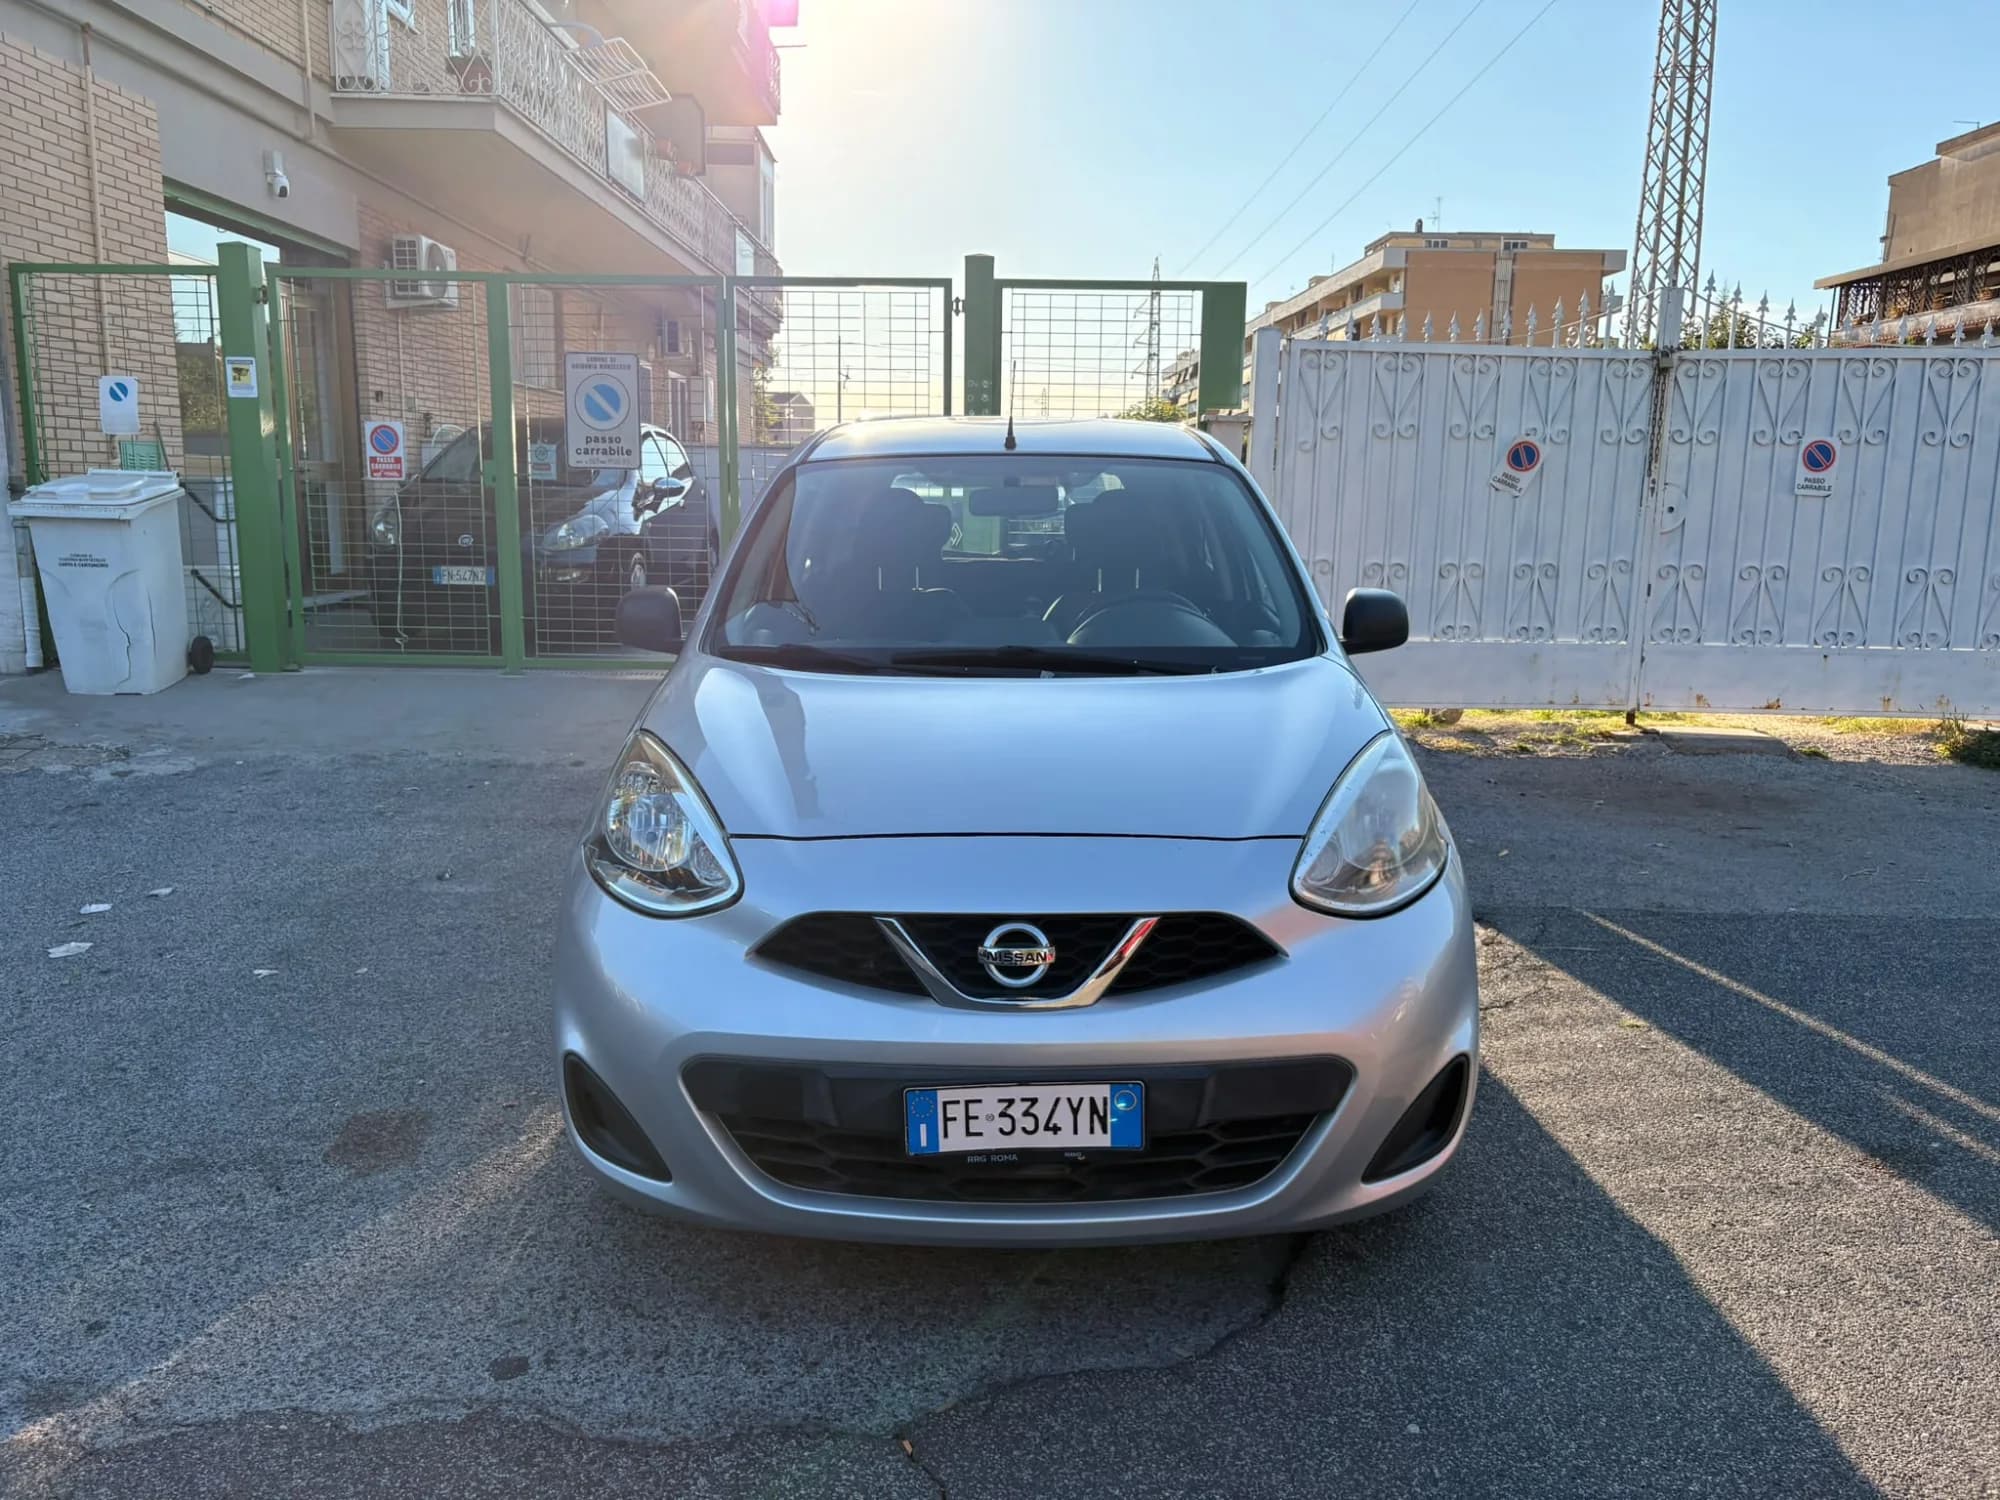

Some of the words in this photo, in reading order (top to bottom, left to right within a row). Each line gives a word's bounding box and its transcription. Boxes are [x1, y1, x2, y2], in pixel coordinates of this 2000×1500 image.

[585, 435, 622, 446] passo
[575, 445, 633, 457] carrabile
[1502, 471, 1521, 484] PASSO
[1803, 476, 1826, 485] PASSO
[1492, 475, 1522, 493] CARRABILE
[1796, 483, 1833, 492] CARRABILE
[985, 951, 1047, 962] NISSAN
[967, 1154, 987, 1164] RRG
[990, 1153, 1019, 1163] ROMA
